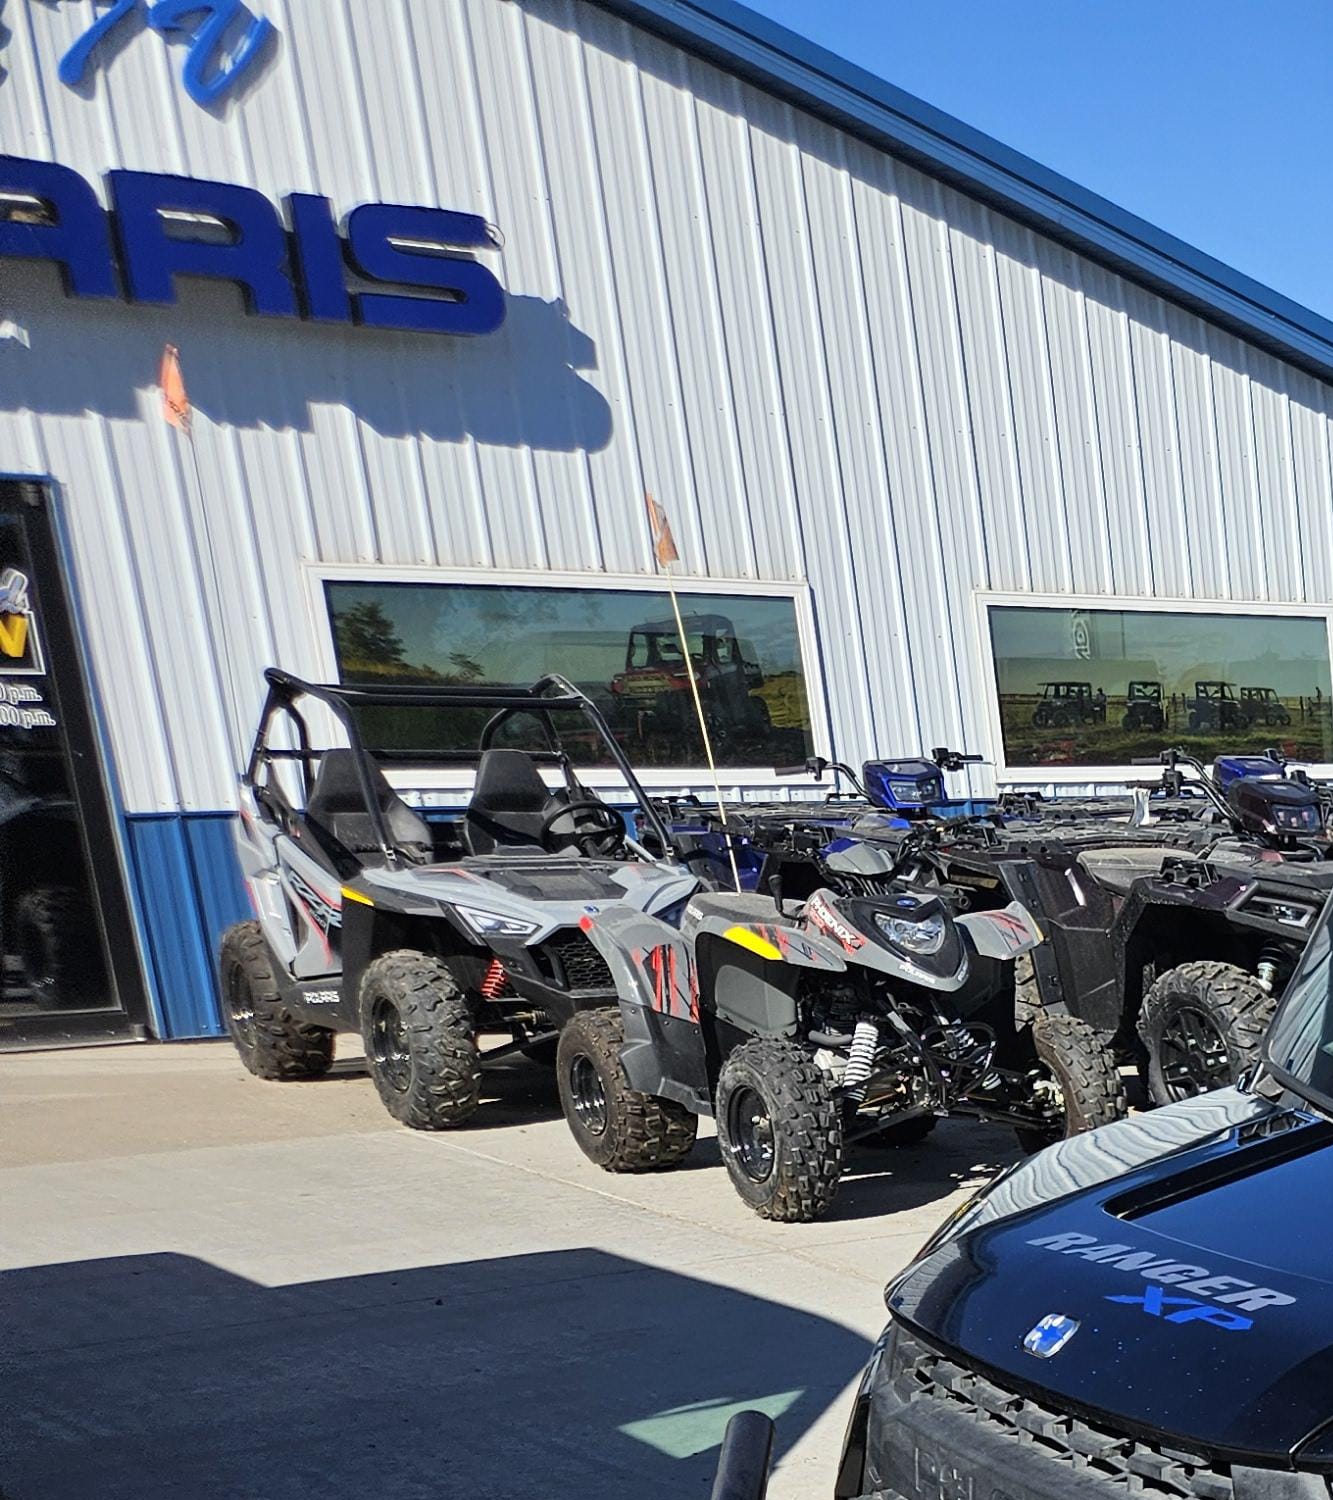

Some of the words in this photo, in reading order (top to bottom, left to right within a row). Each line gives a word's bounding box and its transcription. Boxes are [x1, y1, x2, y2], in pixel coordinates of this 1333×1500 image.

[809, 895, 857, 945] PHOENIX
[1026, 1231, 1298, 1313] RANGER
[1103, 1286, 1254, 1331] XP
